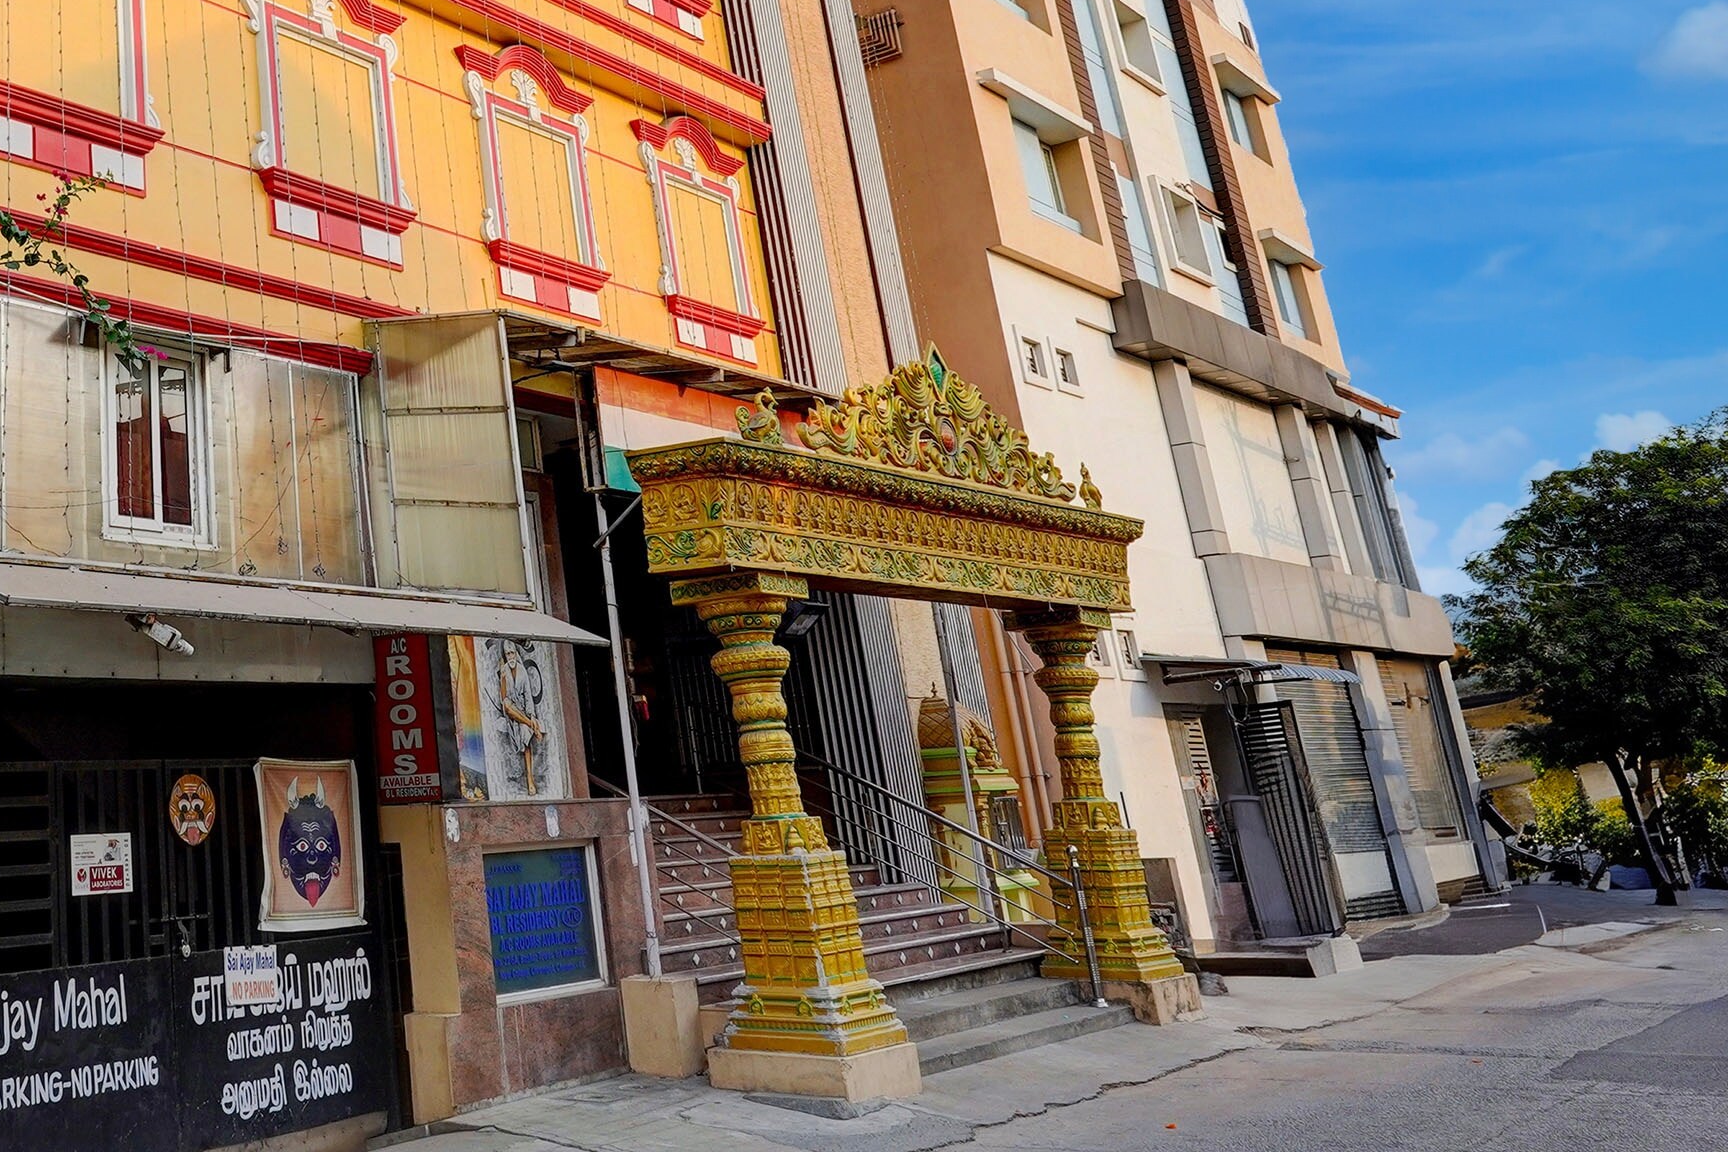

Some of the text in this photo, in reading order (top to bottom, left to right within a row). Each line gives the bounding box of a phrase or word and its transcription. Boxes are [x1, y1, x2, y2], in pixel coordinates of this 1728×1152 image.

[386, 655, 423, 775] ROOMS
[383, 775, 432, 787] AVAILABLE
[396, 787, 430, 797] RESIDENCY
[92, 867, 117, 879] VIVEK
[486, 878, 585, 913] SAI AJAY MAHAL
[506, 909, 561, 933] RESIDENCY
[515, 934, 541, 951] ROOMS
[542, 930, 578, 946] AVAILABLE
[227, 951, 275, 975] Sai Ajay Mahal
[191, 975, 245, 1025] சா
[232, 980, 275, 1000] NO PARKING
[53, 973, 128, 1032] Mahal
[227, 1009, 353, 1061] வாகனம் நிறுத்த
[222, 1058, 353, 1121] அனுமதி இல்லை
